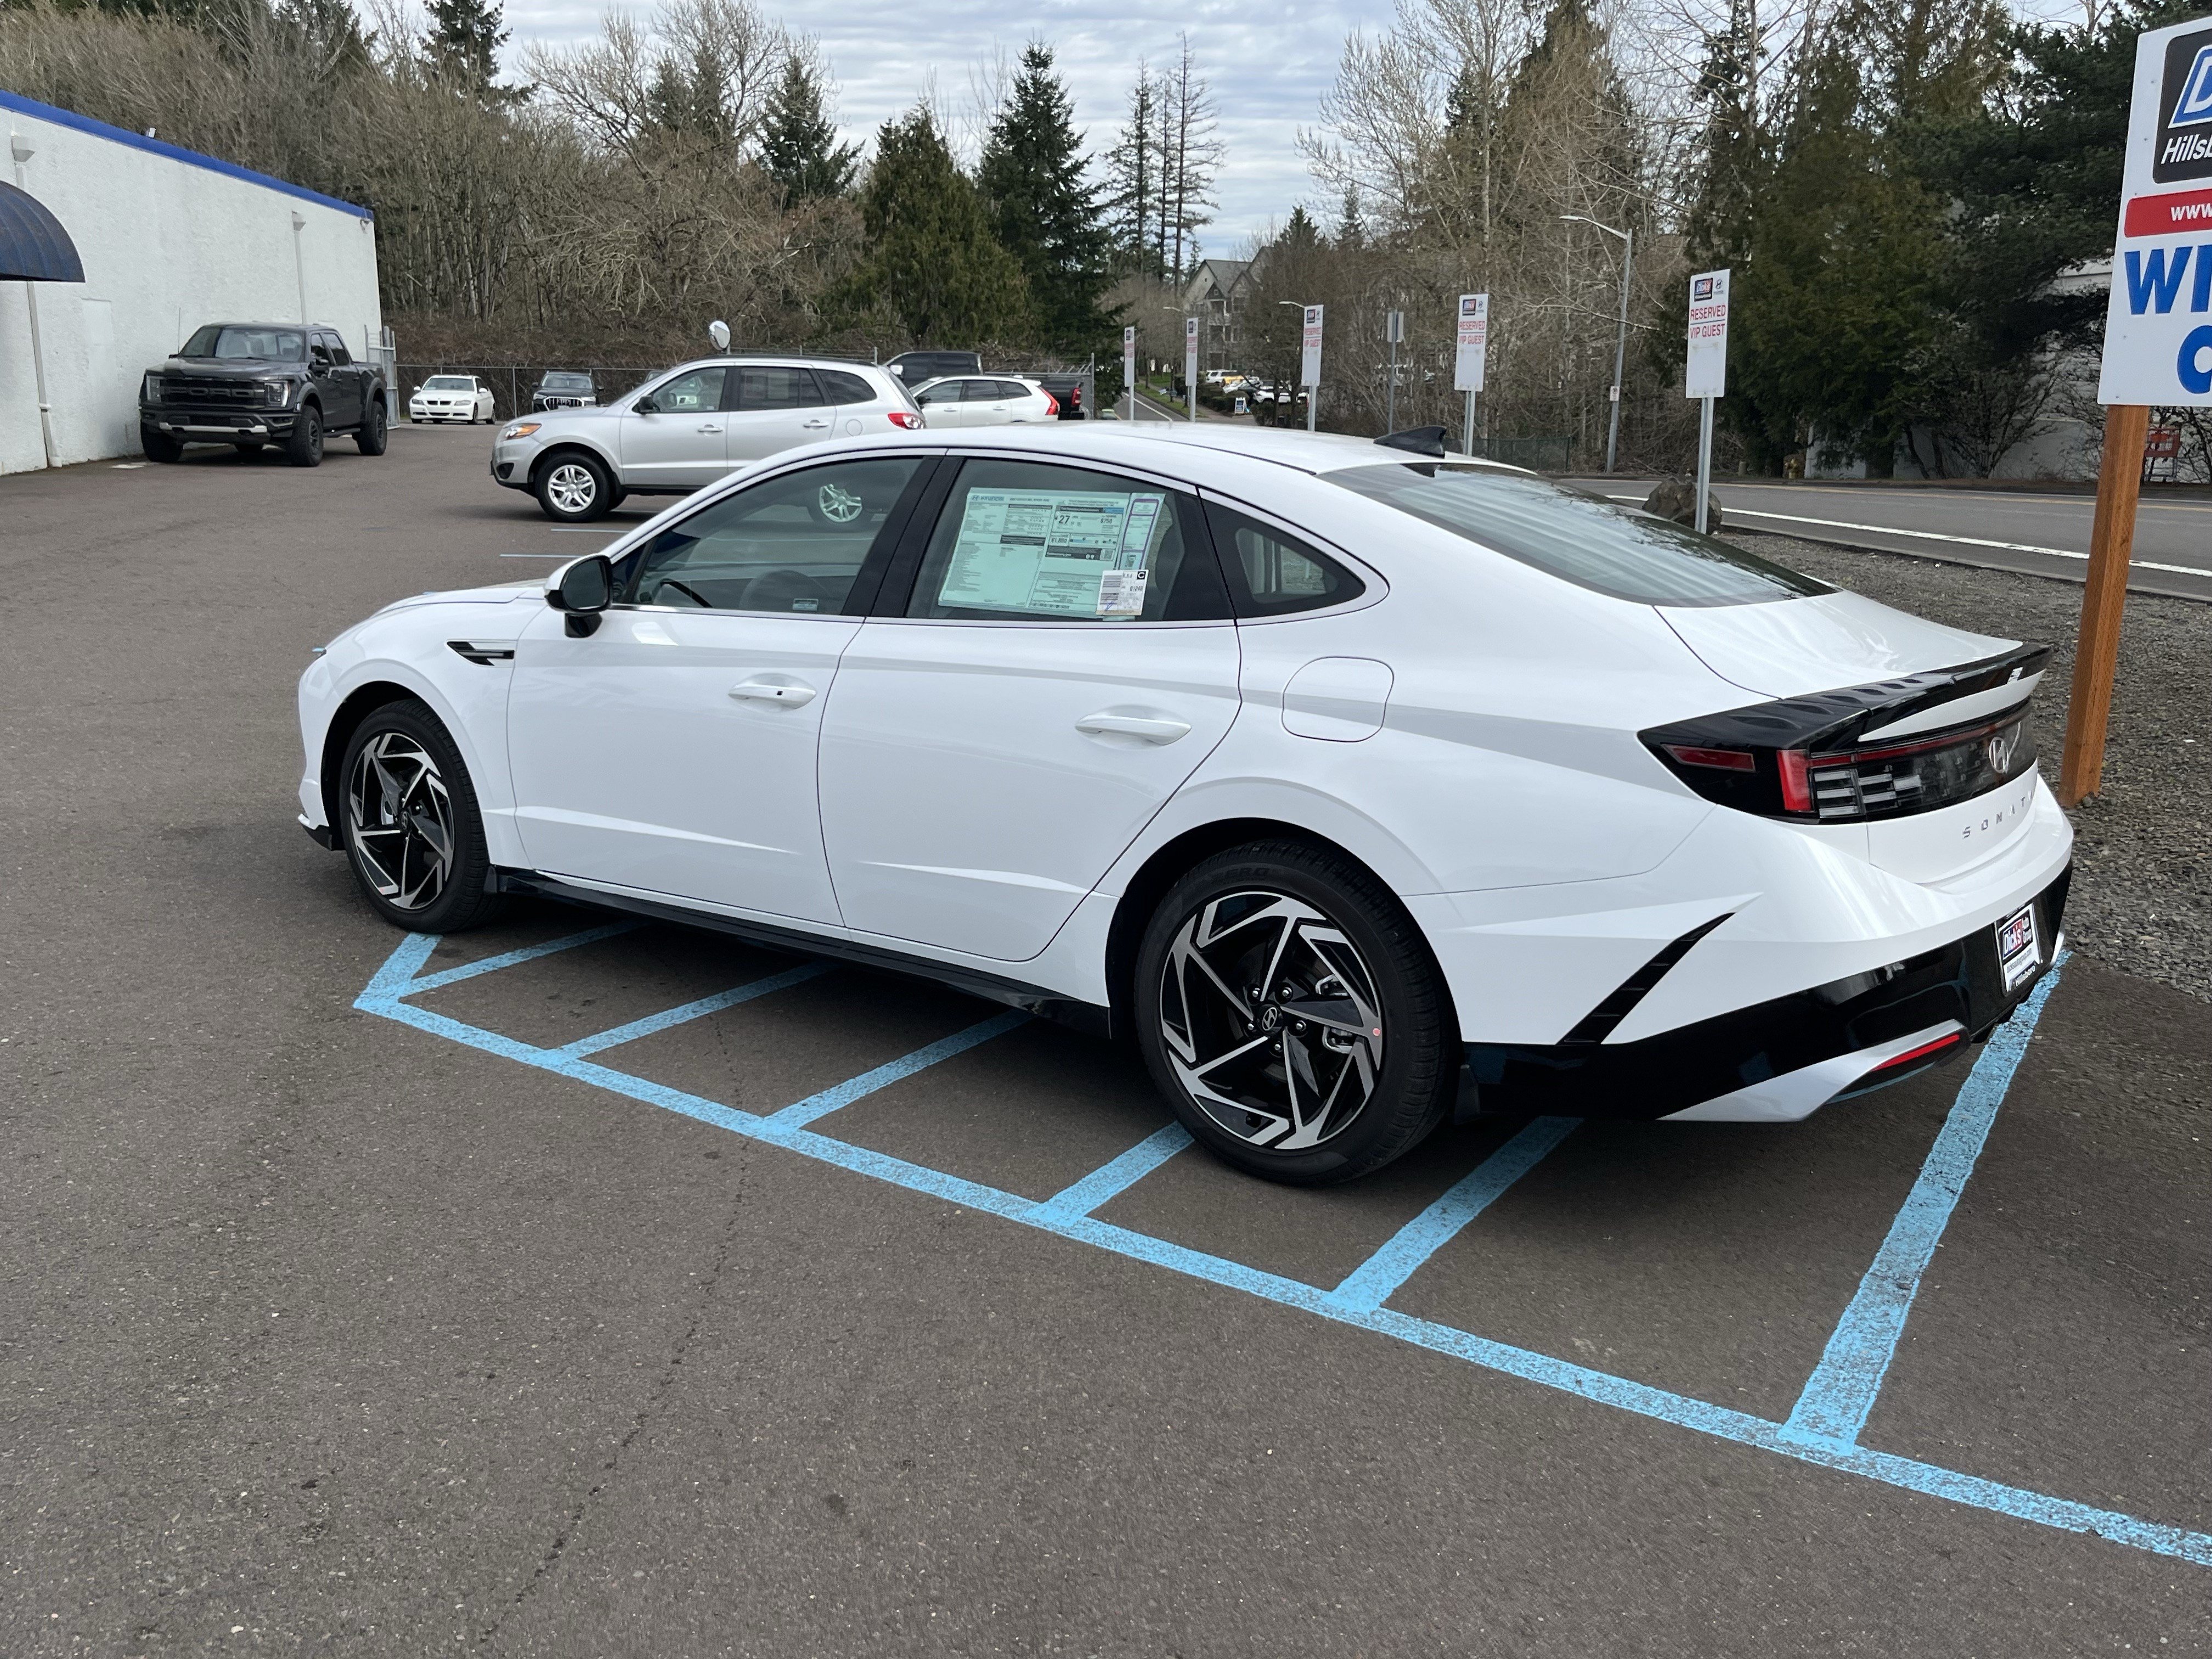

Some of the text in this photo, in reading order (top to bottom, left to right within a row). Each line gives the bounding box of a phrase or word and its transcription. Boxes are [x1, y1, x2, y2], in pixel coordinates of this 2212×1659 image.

[2124, 245, 2212, 315] WI
[1690, 304, 1726, 321] RESERVED
[1690, 323, 1725, 339] VIP GUEST
[2004, 924, 2022, 955] Dick's
[1059, 1064, 1070, 1073] 27
